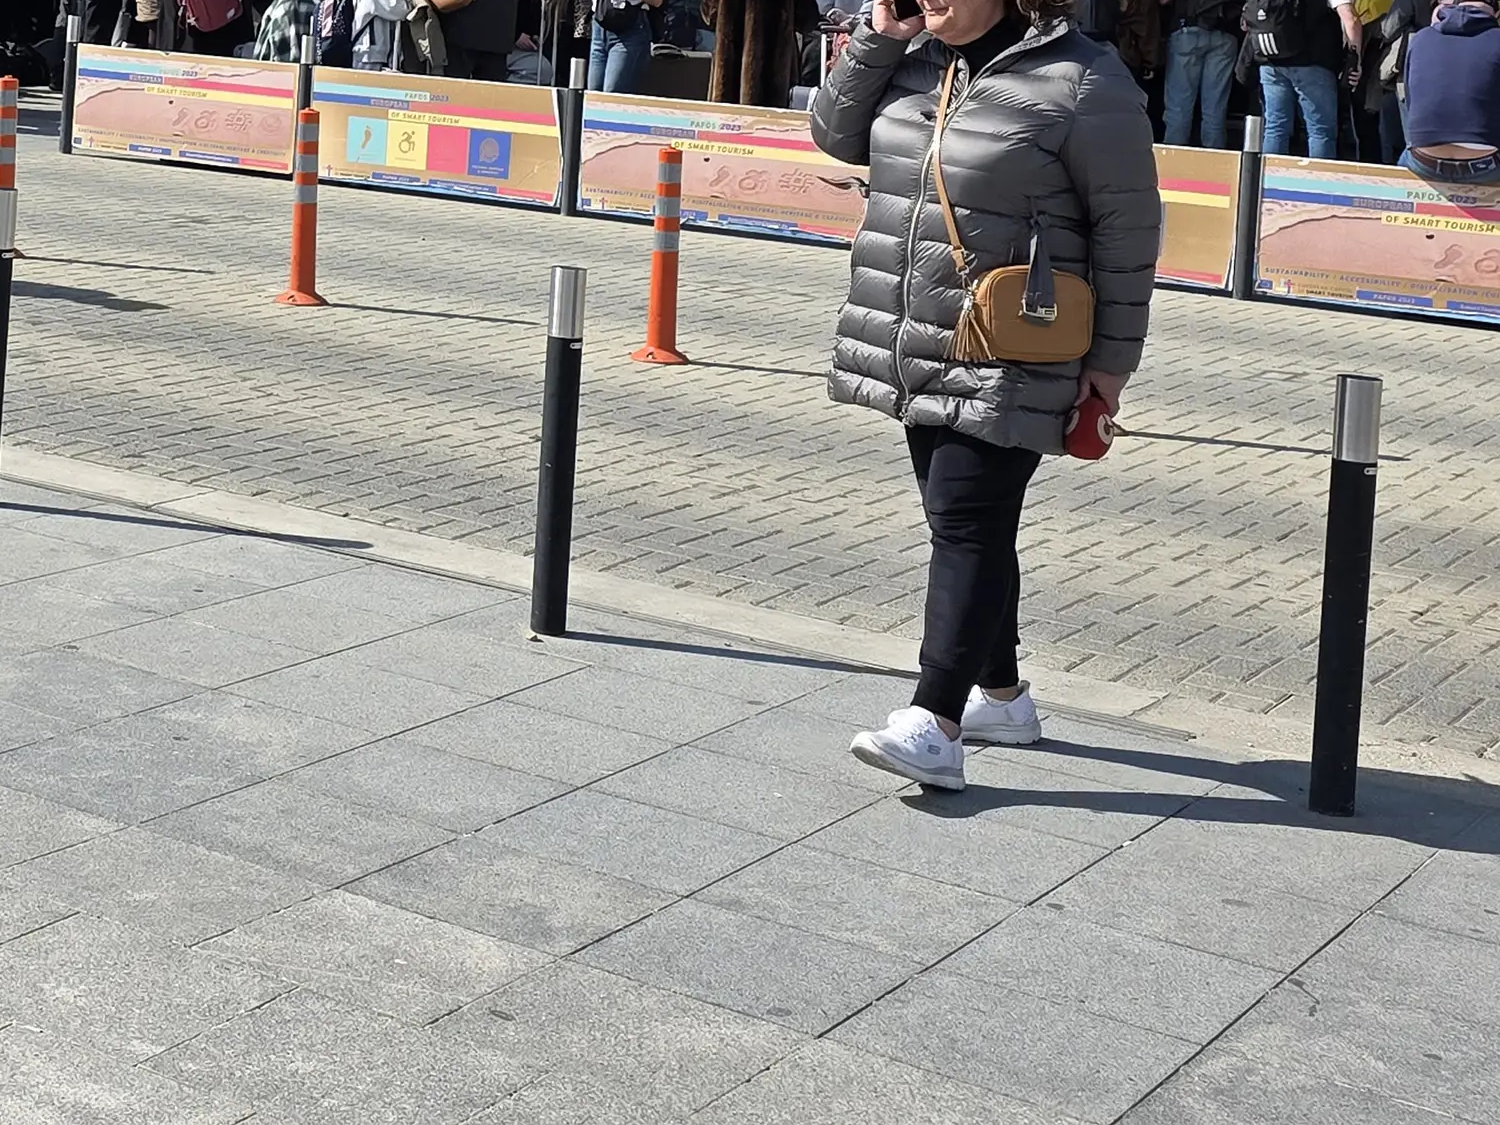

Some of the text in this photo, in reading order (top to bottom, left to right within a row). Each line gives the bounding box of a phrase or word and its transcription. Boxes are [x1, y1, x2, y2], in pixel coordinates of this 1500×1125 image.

[402, 113, 426, 121] SMART
[428, 115, 460, 124] TOURISM
[690, 120, 717, 130] PAFOS
[688, 142, 715, 152] SMART
[717, 146, 754, 155] TOURISM
[1407, 191, 1442, 202] PAFOS
[1385, 215, 1495, 233] OF SMART TOURISM
[1265, 267, 1330, 279] SUSTAINABILITY
